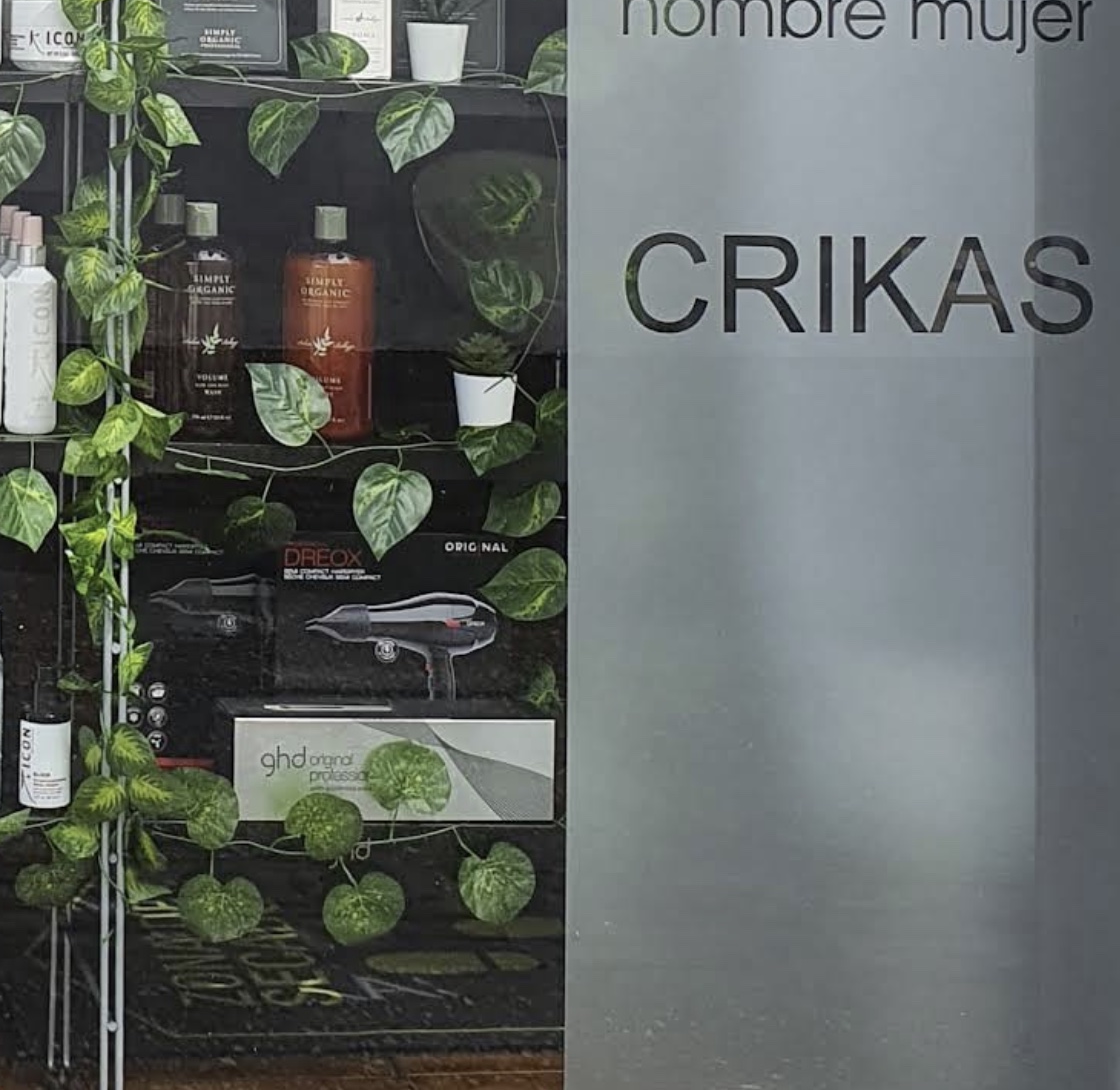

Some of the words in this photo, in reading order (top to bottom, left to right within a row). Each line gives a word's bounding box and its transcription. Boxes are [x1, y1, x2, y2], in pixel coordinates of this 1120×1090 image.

[624, 232, 1095, 335] CRIKAS
[284, 548, 362, 567] DREOX
[444, 542, 508, 553] ORIGNAL
[261, 745, 306, 777] ghd
